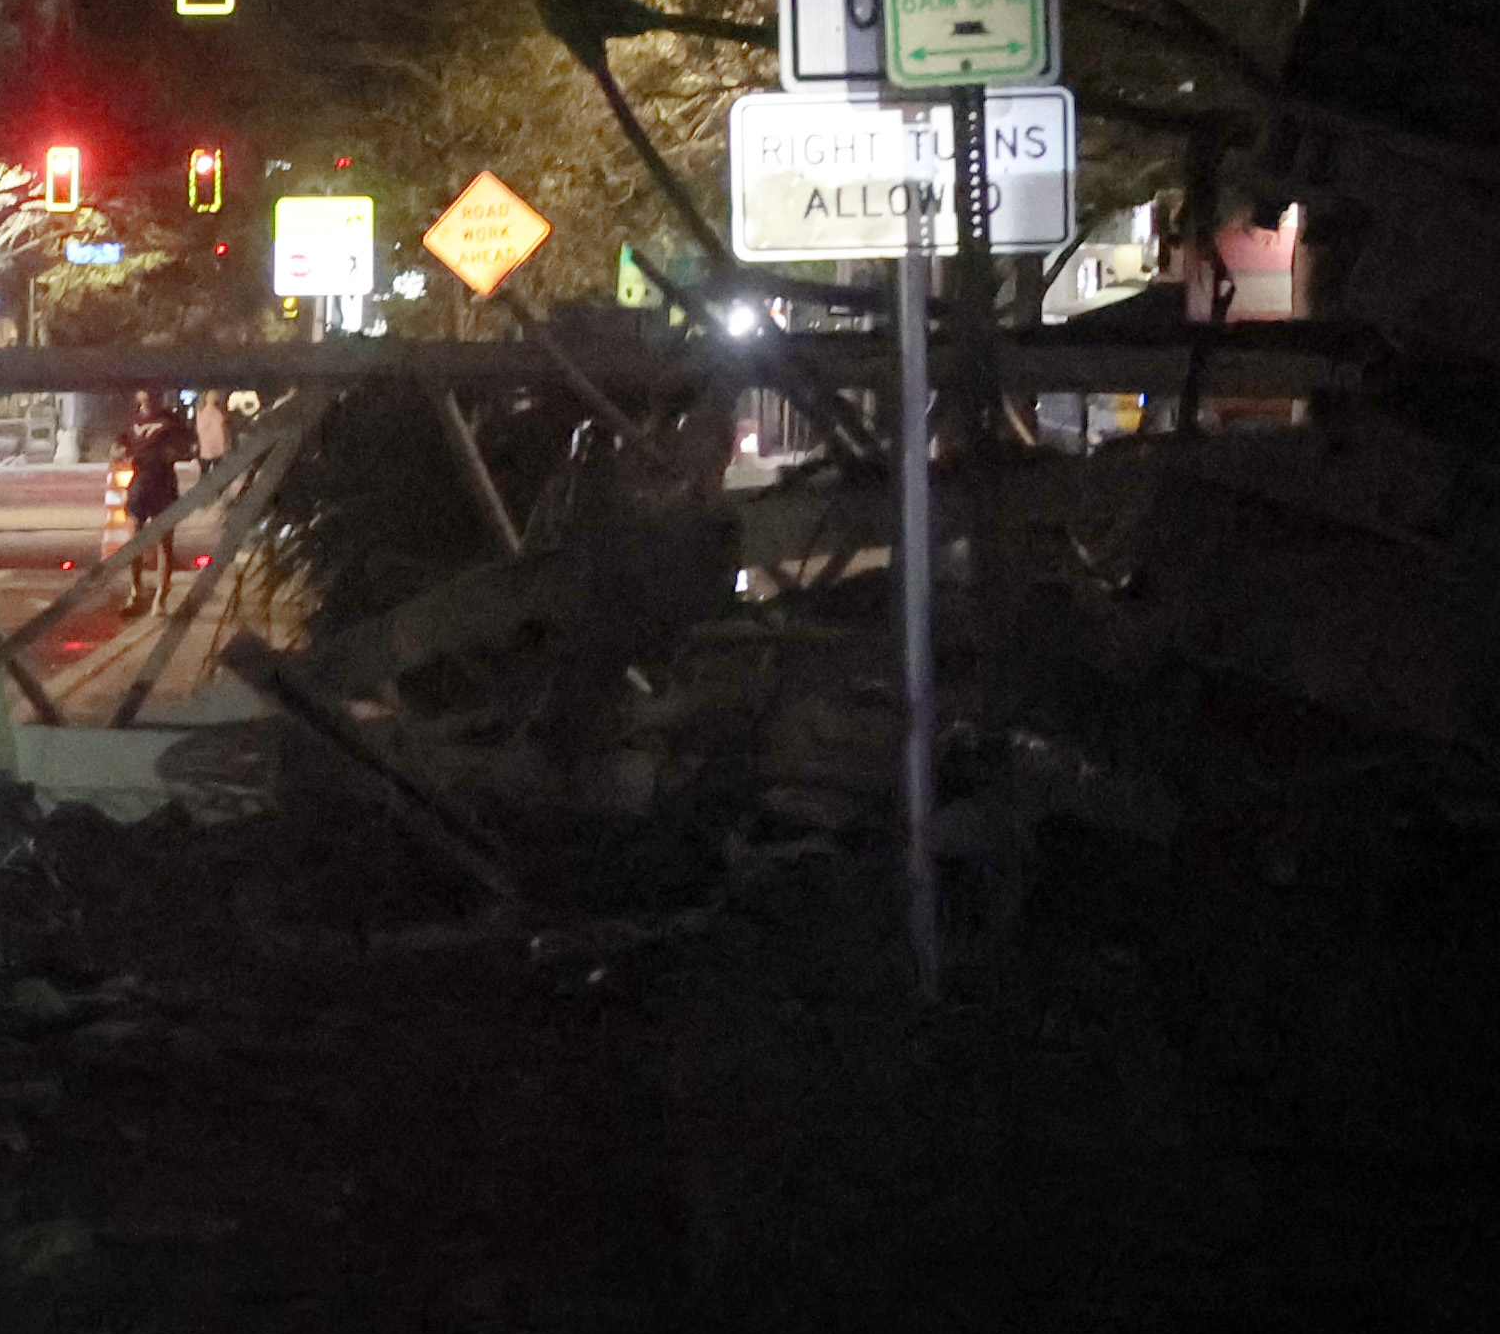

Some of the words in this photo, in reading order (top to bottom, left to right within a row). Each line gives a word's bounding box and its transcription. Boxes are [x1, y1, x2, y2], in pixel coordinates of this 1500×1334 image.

[762, 132, 881, 166] RIGHT
[908, 126, 1048, 162] TUNS
[804, 182, 1001, 220] ALLOWD
[461, 203, 510, 220] ROAD
[463, 225, 511, 243] WORK
[459, 247, 518, 264] AHEAD
